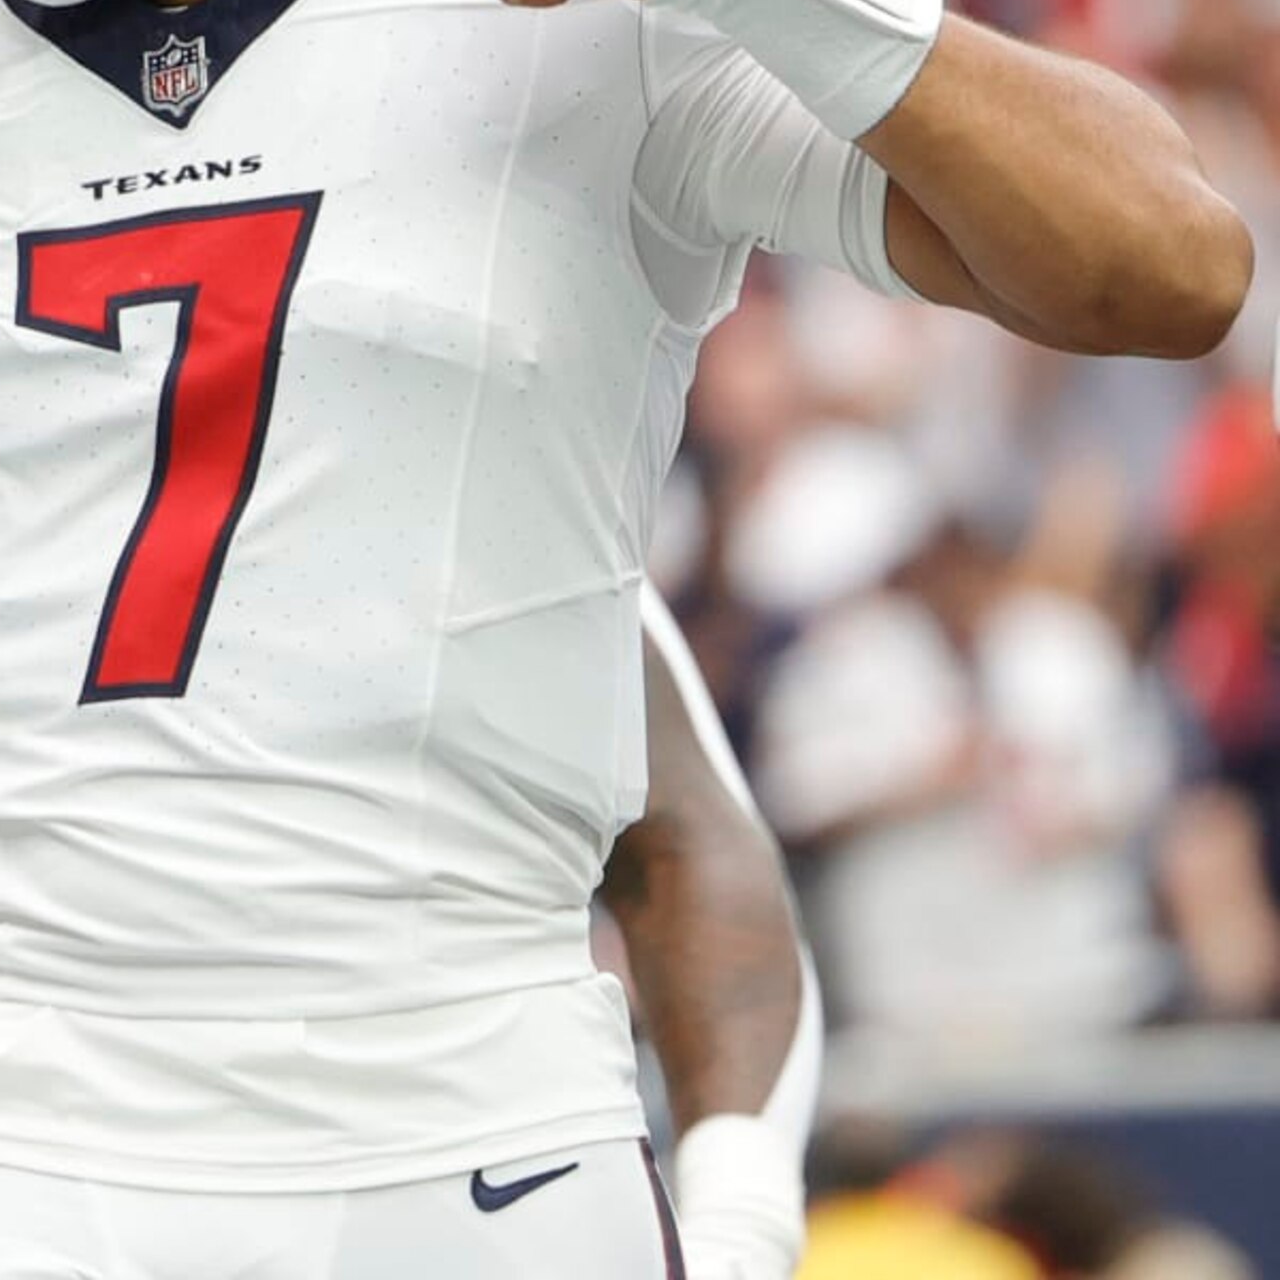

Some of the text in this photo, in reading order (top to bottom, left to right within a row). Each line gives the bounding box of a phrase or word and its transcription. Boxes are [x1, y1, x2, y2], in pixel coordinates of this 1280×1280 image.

[154, 66, 195, 103] NFL
[81, 154, 263, 201] TEXANS
[14, 189, 325, 705] 7
